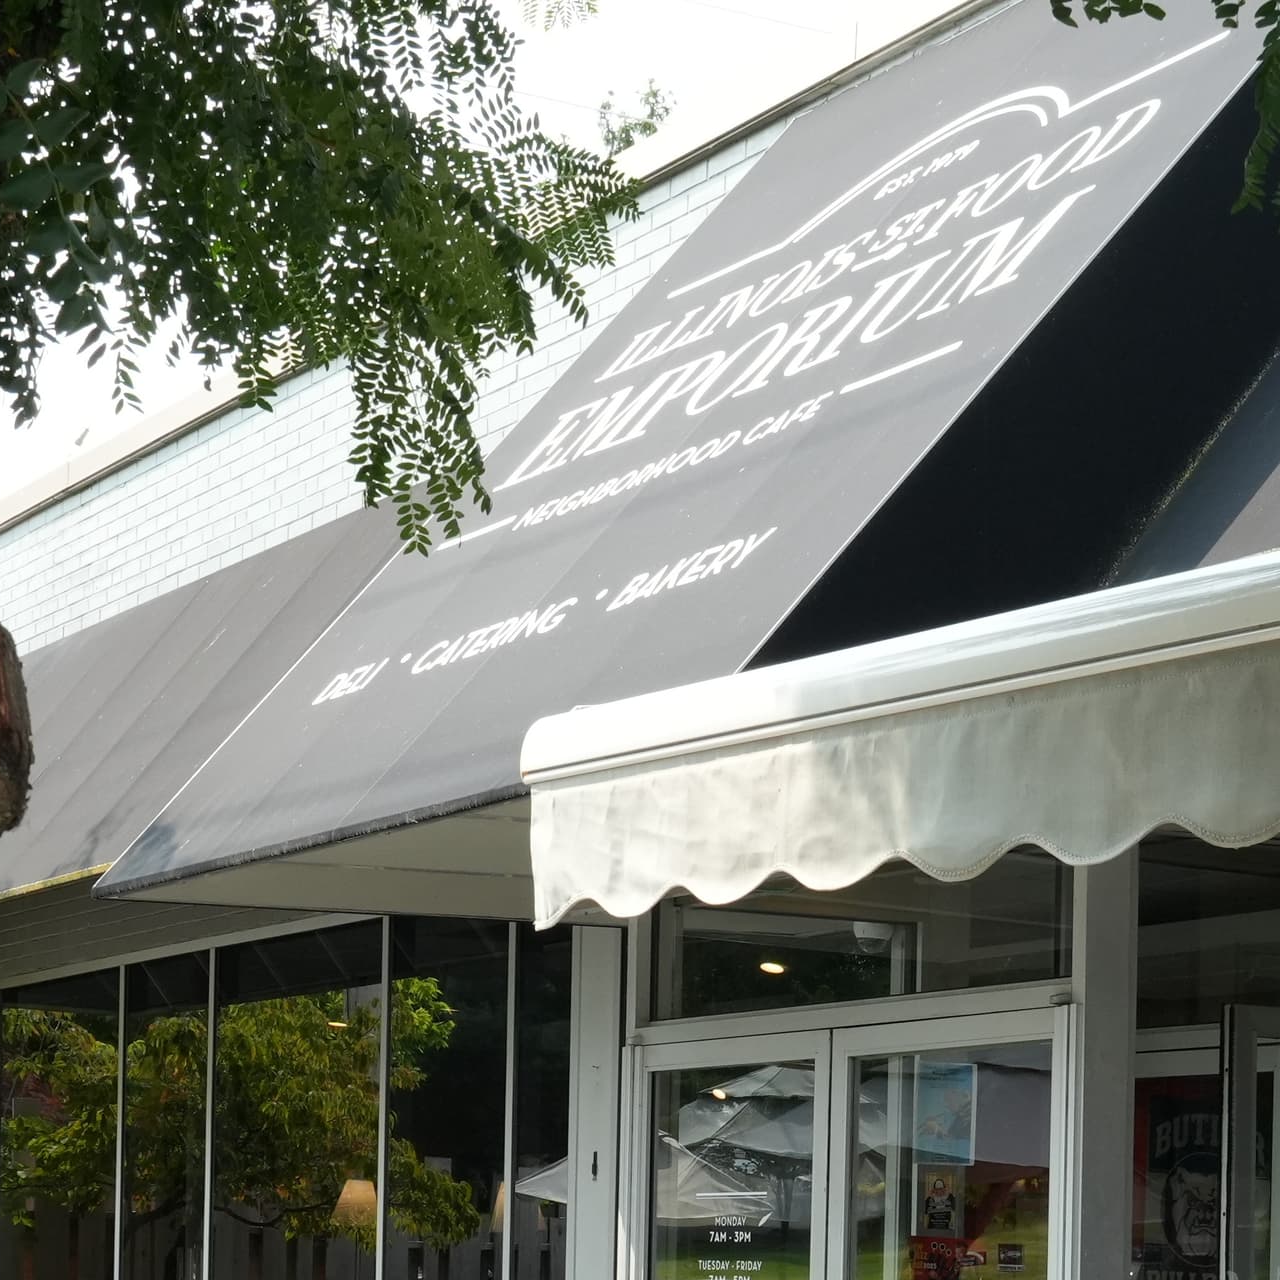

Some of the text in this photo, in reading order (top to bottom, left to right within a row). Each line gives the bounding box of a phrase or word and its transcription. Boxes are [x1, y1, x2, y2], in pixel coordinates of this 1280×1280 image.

[872, 165, 924, 201] EST.
[593, 229, 877, 384] ILLINOIS
[913, 98, 1161, 246] FOOD
[492, 184, 1097, 493] EMPORIUM
[511, 430, 742, 532] NEIGHBORHOOD
[311, 526, 779, 706] DELI CATERING BAKERY
[709, 1231, 727, 1243] 7AM
[734, 1231, 752, 1243] 3PM
[714, 1215, 747, 1227] MONDAY
[698, 1260, 730, 1271] TUESDAY
[736, 1260, 762, 1271] FRIDAY
